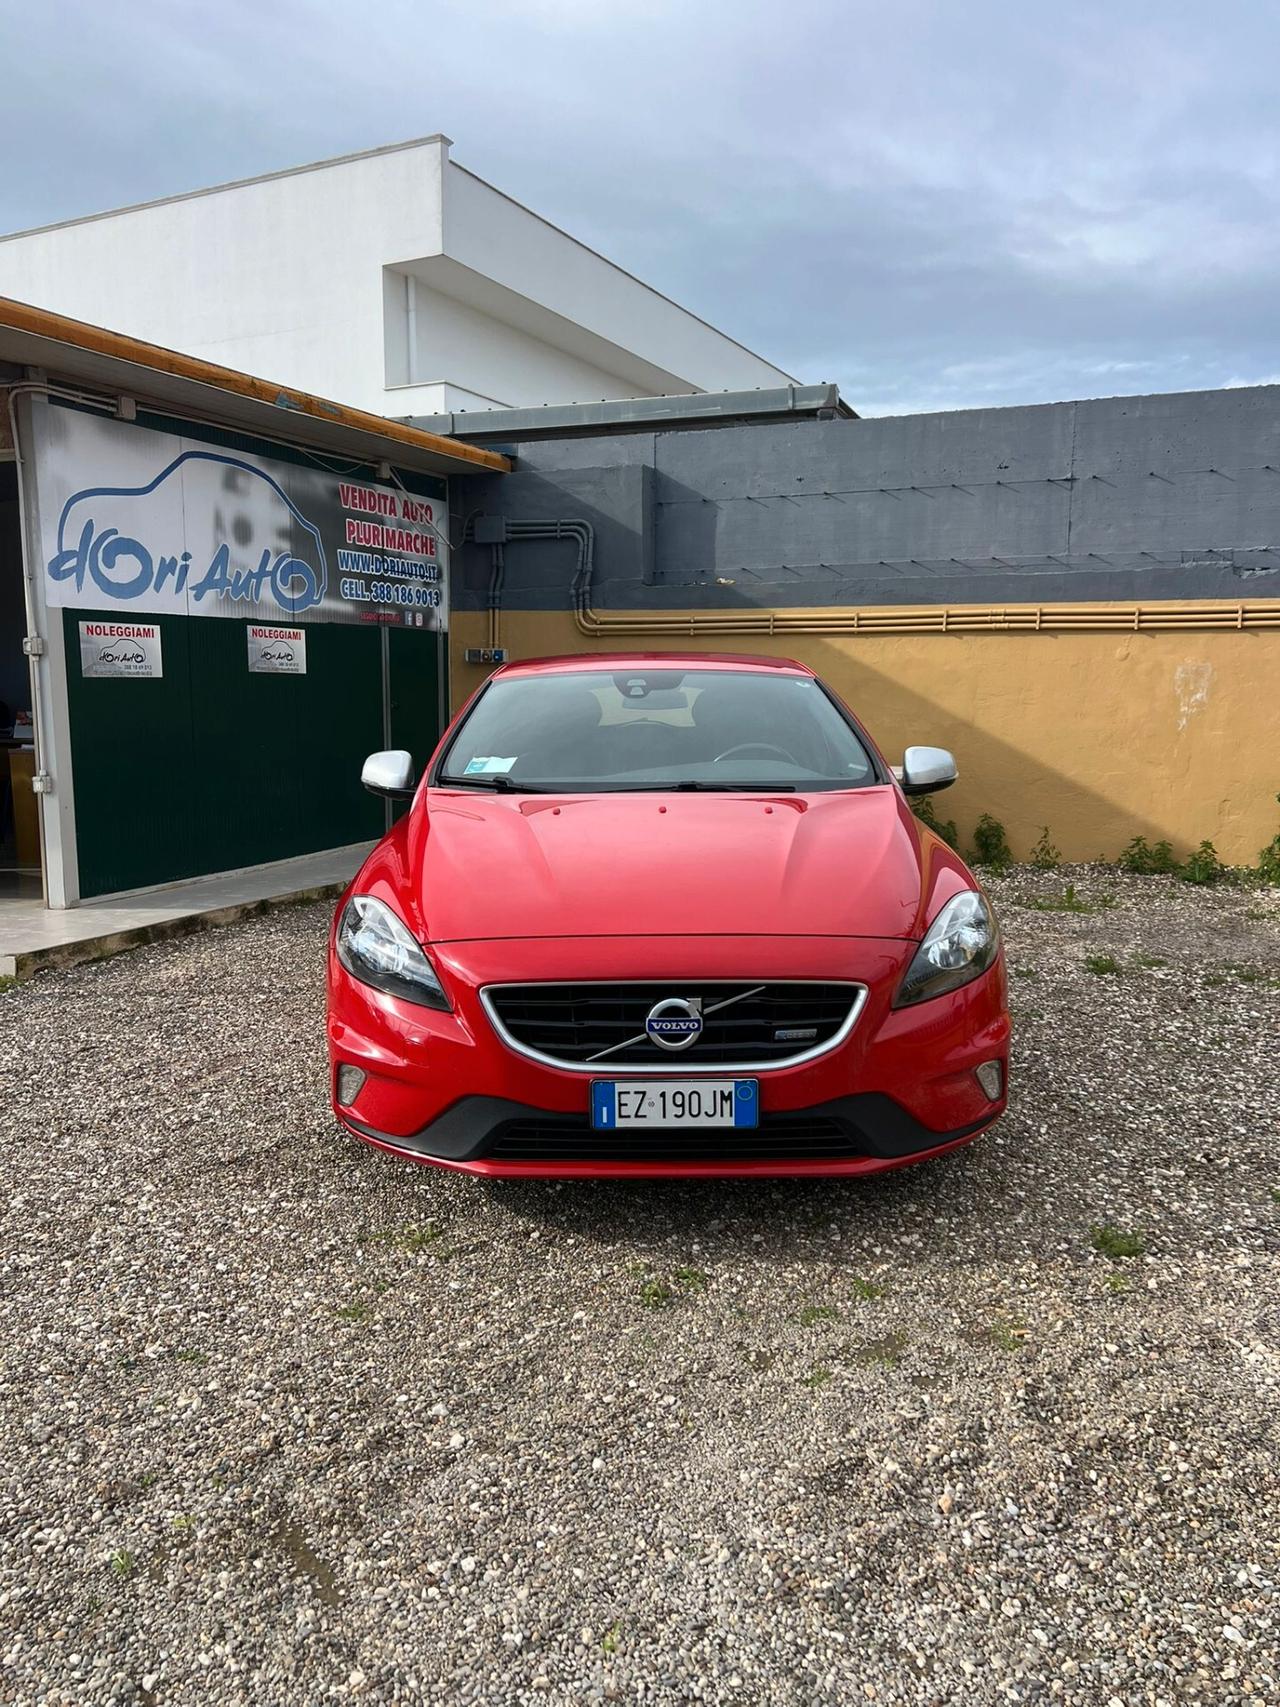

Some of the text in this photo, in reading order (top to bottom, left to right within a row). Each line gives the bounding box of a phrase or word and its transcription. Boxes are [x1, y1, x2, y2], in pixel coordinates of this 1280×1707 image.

[339, 482, 433, 525] VENDITA AUTO
[346, 518, 436, 557] PLURIMARCHE
[337, 549, 438, 583] WWW.DORIAUTO.IT
[340, 578, 440, 608] CELL. 388 186 9013
[86, 625, 155, 638] NOLEGGIAMI
[252, 628, 301, 640] NOLEGGIAMI
[651, 1021, 699, 1030] VOLVO
[617, 1090, 647, 1119] EZ
[659, 1090, 733, 1119] 190JM
